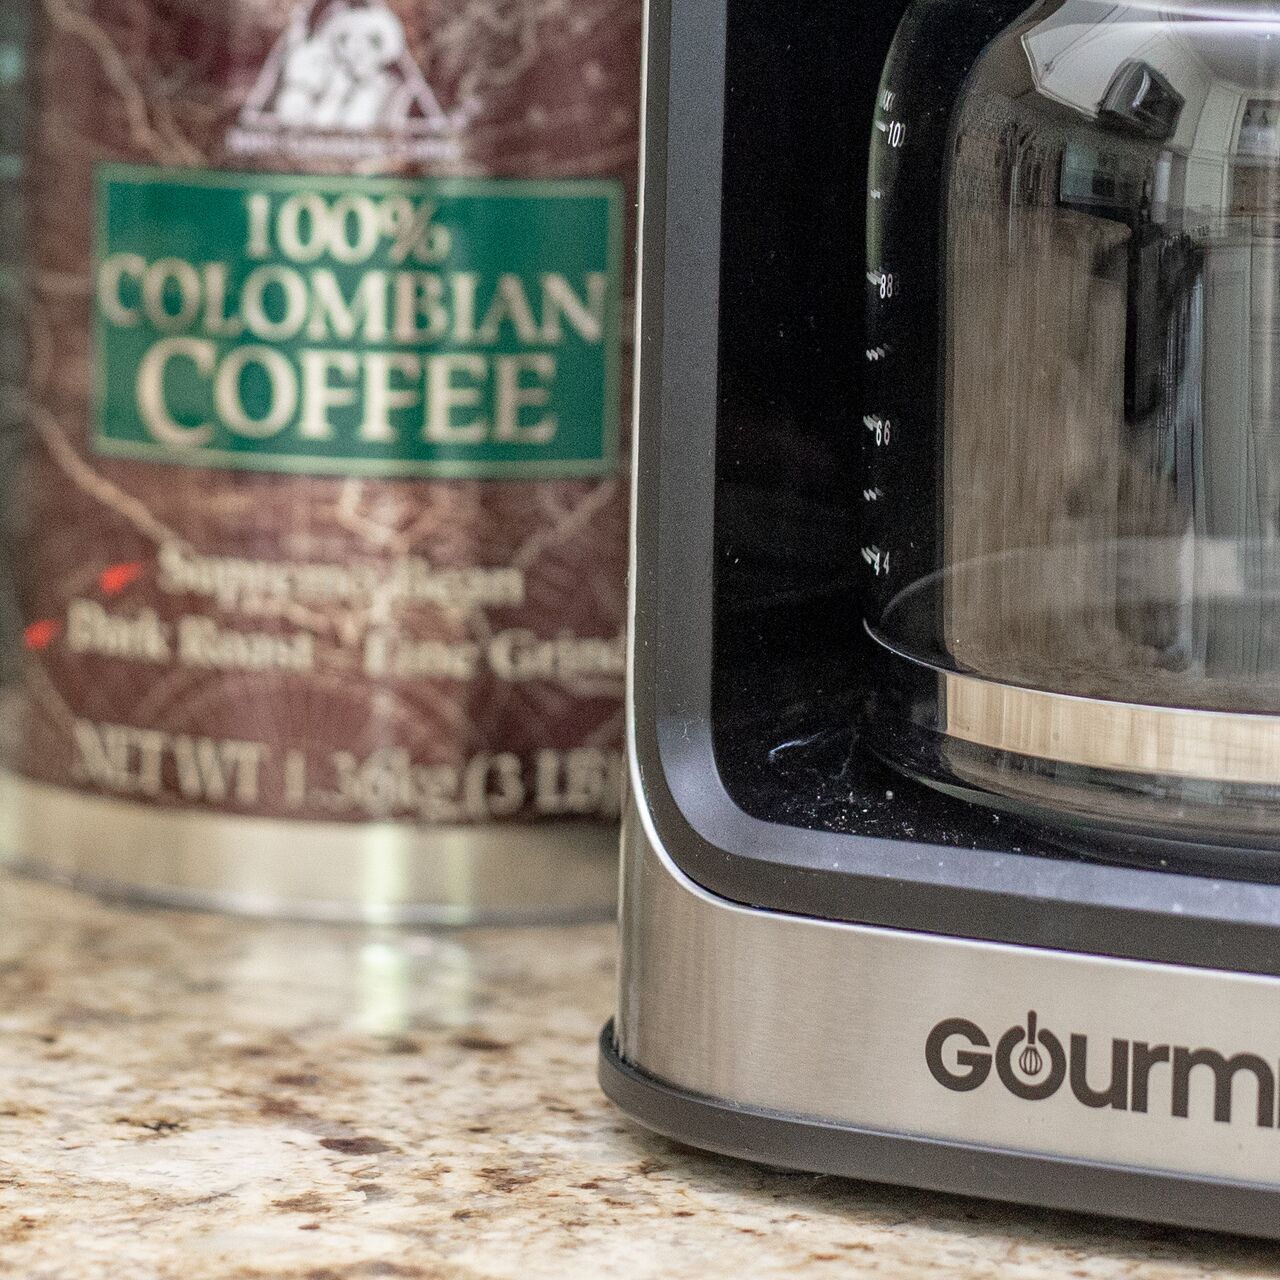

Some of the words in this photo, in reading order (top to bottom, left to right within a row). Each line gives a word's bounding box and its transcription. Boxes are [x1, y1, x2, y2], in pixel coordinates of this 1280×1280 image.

[246, 191, 451, 265] 100%
[96, 251, 609, 345] COLOMBIAN
[135, 335, 560, 450] COFFEE
